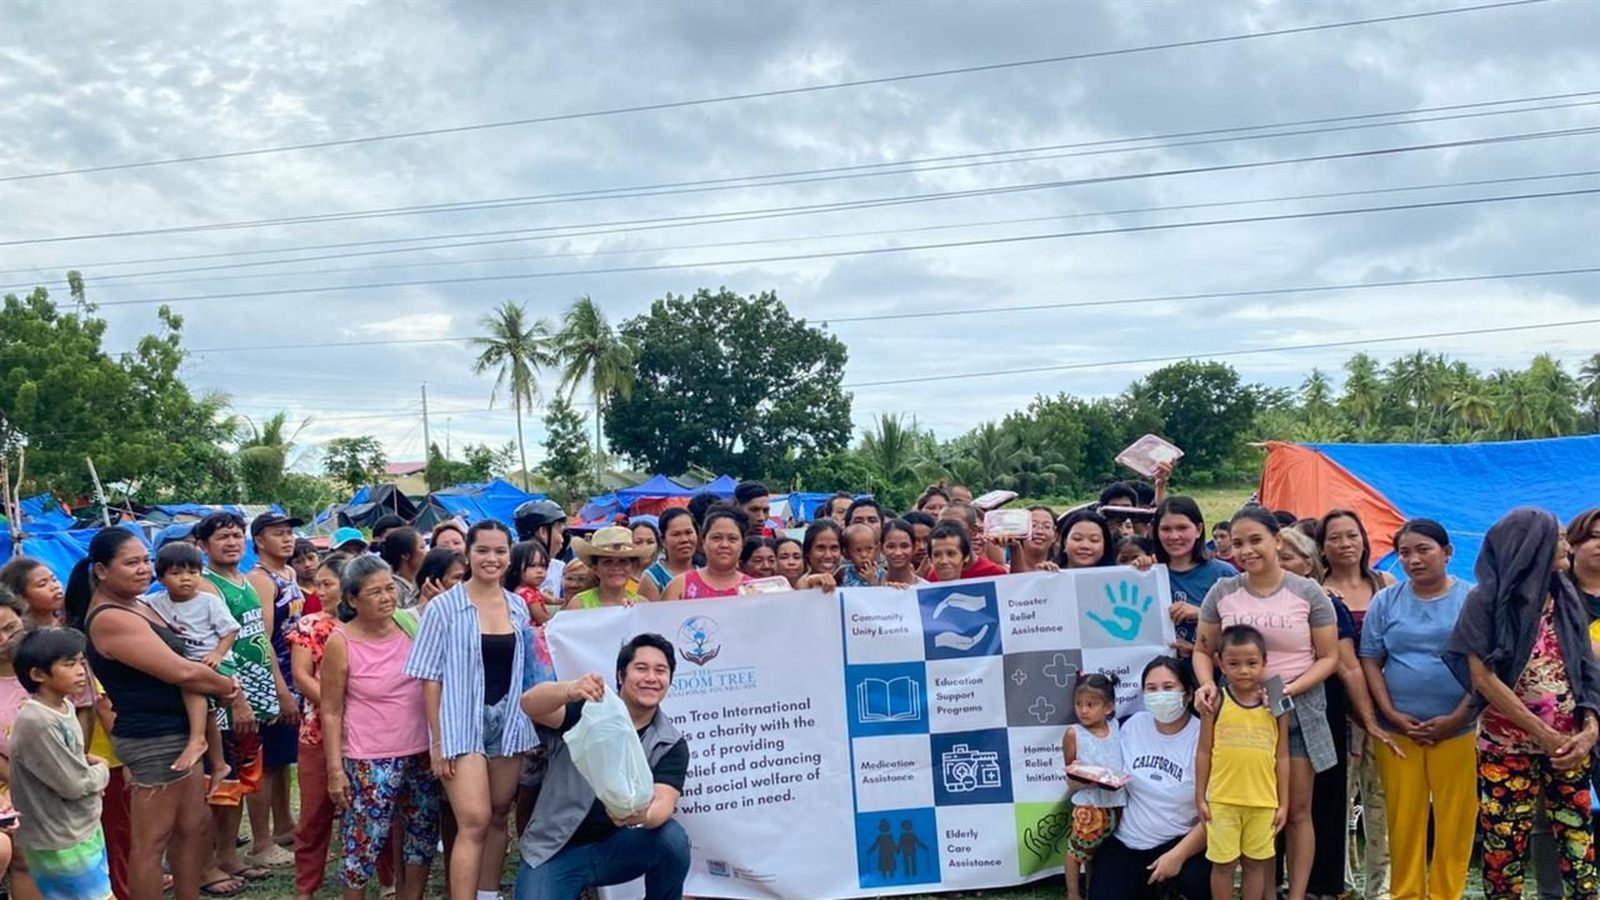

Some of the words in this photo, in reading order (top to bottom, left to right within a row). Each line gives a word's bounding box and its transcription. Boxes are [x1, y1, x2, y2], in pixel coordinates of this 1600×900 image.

[1008, 597, 1048, 607] Disaster
[851, 612, 904, 622] Community
[1009, 610, 1036, 622] Relief
[852, 627, 877, 638] Unity
[878, 625, 909, 635] Events
[1011, 625, 1063, 636] Assistance
[1098, 665, 1130, 676] Social
[671, 677, 713, 692] SDOM
[718, 672, 755, 686] TREE
[935, 677, 983, 687] Education
[936, 691, 975, 702] Support
[690, 710, 719, 722] Tree
[723, 698, 811, 719] International
[937, 704, 983, 714] Programs
[697, 732, 705, 740] a
[710, 723, 757, 738] charity
[760, 718, 790, 732] with
[793, 716, 815, 729] the
[703, 744, 715, 757] of
[720, 739, 784, 759] providing
[686, 762, 715, 778] elief
[720, 758, 746, 773] and
[750, 752, 821, 770] advancing
[860, 759, 915, 770] Medication
[1025, 758, 1052, 767] Relief
[1132, 755, 1183, 782] CALIFORNIA
[706, 777, 747, 794] social
[751, 773, 803, 787] welfare
[807, 767, 821, 780] of
[862, 773, 914, 784] Assistance
[682, 802, 711, 814] who
[715, 802, 738, 811] are
[742, 796, 754, 807] in
[758, 789, 796, 804] need.
[945, 829, 979, 840] Elderly
[947, 844, 972, 853] Care
[948, 858, 1002, 867] Assistance
